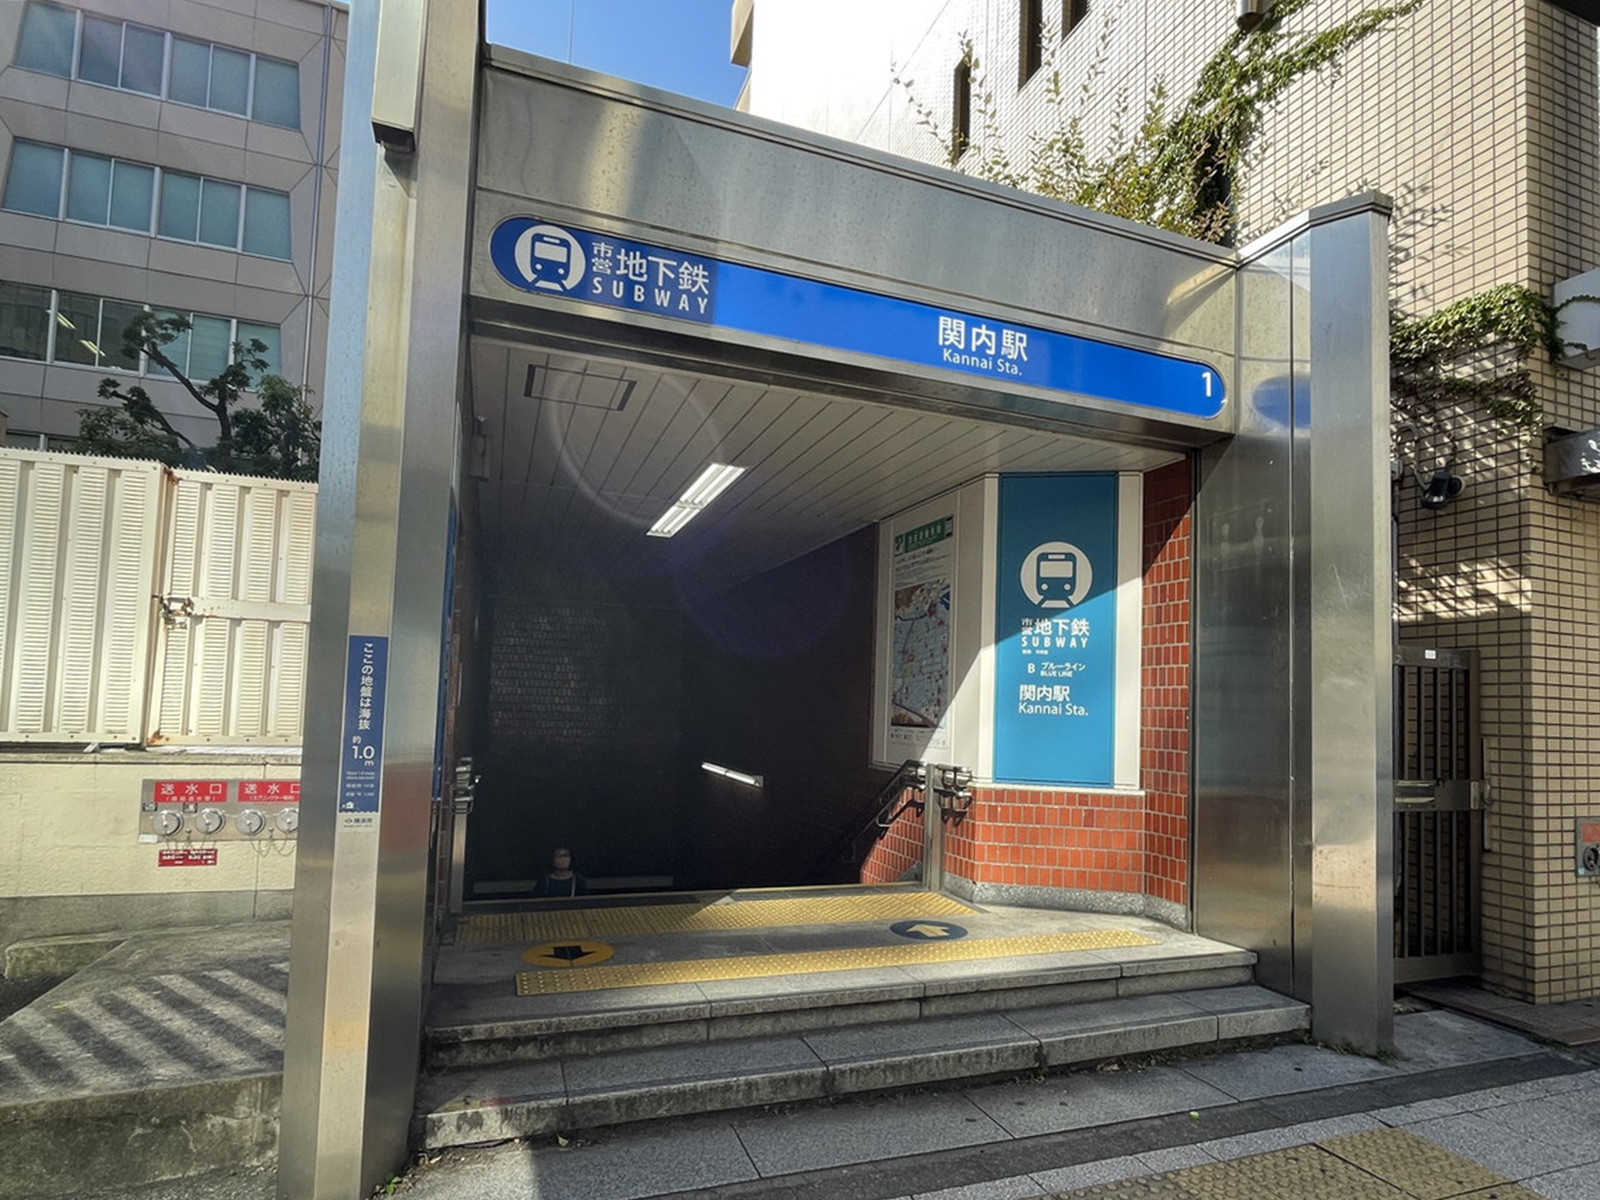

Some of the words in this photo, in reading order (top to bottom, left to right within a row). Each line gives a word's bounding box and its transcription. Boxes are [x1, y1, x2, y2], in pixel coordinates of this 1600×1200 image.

[592, 278, 708, 314] SUBWAY
[938, 316, 1028, 362] 関内駅
[943, 348, 993, 371] Kannai
[997, 359, 1022, 376] Sta.
[1202, 371, 1212, 397] 1
[1021, 636, 1088, 648] SUBWAY
[1041, 661, 1086, 671] ブルーライン
[1019, 684, 1070, 702] 関内駅
[1018, 702, 1062, 715] Kannai
[1065, 703, 1089, 716] Sta.
[352, 745, 375, 759] 1.0
[160, 783, 222, 795] 送水口
